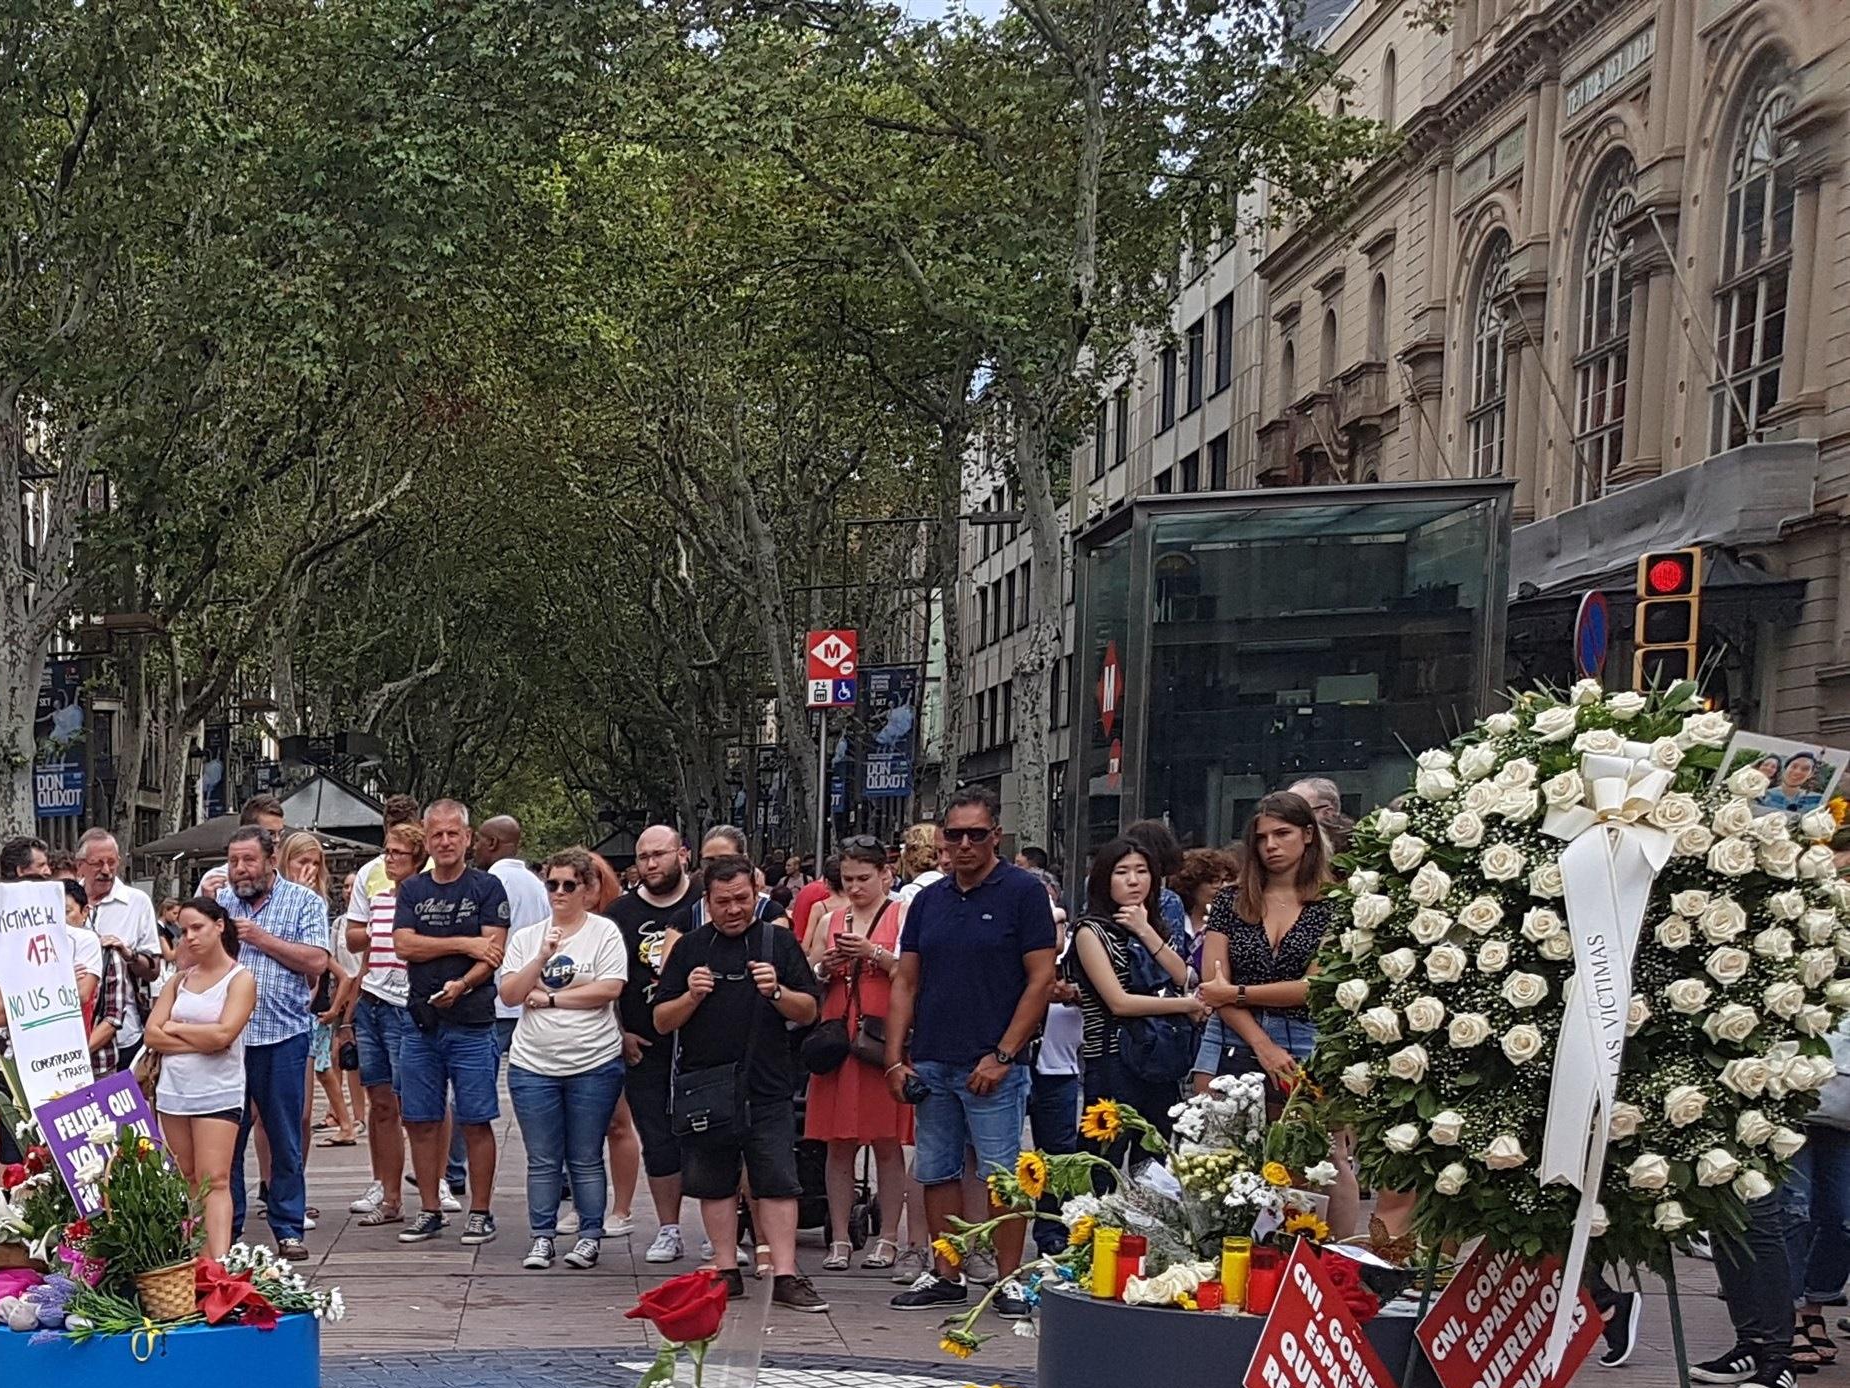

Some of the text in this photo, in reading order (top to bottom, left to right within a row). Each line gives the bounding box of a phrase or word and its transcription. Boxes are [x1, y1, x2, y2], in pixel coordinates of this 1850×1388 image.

[824, 643, 841, 659] M
[36, 773, 65, 792] DON
[866, 761, 891, 775] DON
[37, 788, 83, 808] QUIXOT
[1587, 934, 1619, 1030] VICTIMAS
[7, 994, 25, 1021] NO
[28, 987, 51, 1012] US
[107, 1088, 138, 1117] QUI
[1293, 1262, 1324, 1321] CNI,
[1465, 1264, 1540, 1363] ESPAÑOL,
[1431, 1315, 1468, 1361] CNI,
